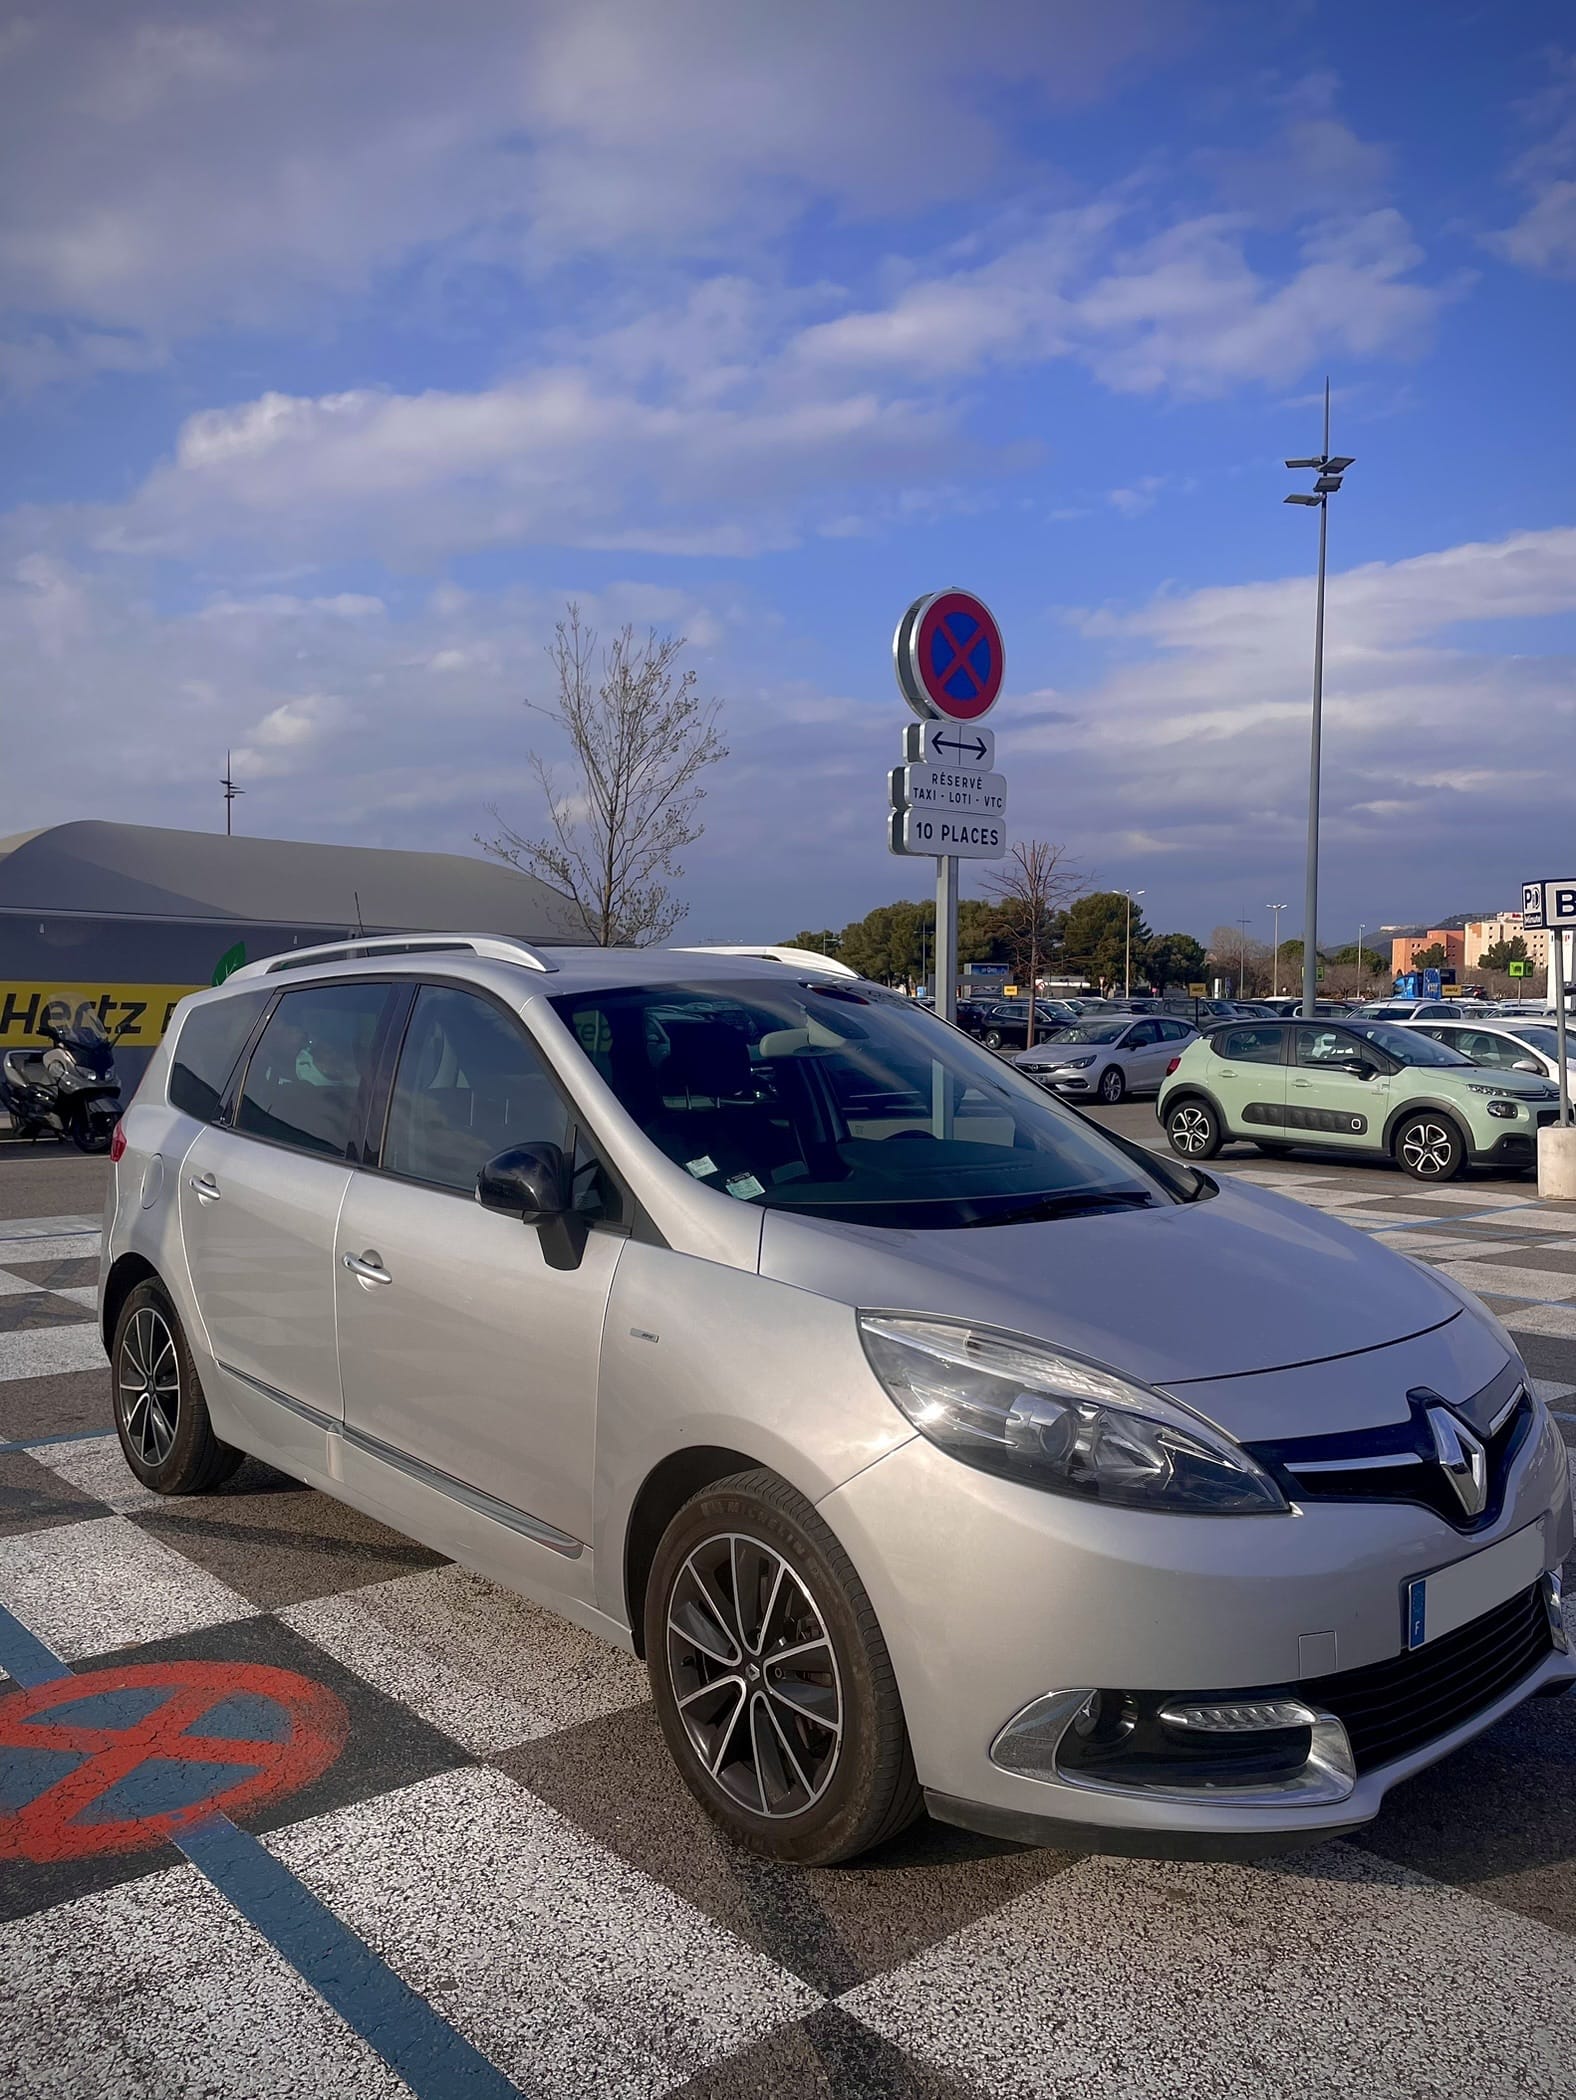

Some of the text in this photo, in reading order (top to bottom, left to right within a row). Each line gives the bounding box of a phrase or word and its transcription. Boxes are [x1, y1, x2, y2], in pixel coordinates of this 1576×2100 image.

[932, 772, 982, 789] RÉSERVÉ
[913, 788, 936, 800] TAXI
[949, 792, 971, 804] LOTI
[985, 796, 1002, 808] VTC
[916, 822, 999, 845] 10 PLACES
[0, 993, 147, 1034] Hertz
